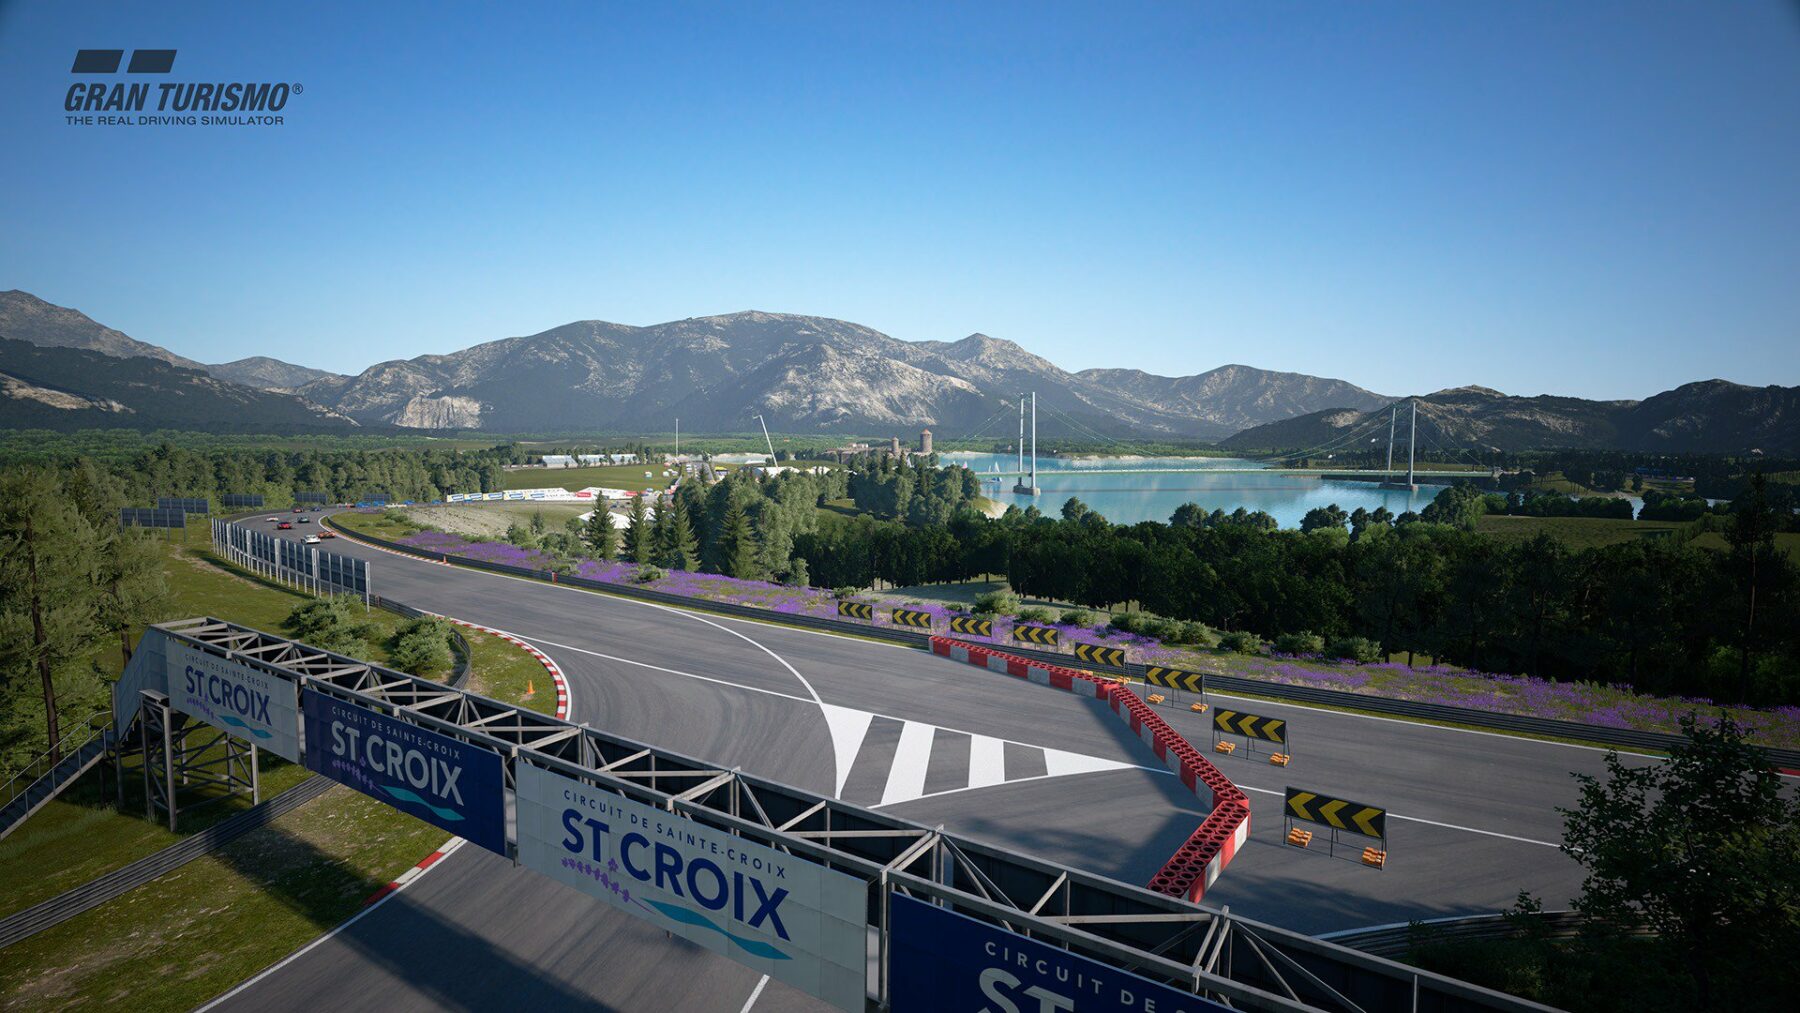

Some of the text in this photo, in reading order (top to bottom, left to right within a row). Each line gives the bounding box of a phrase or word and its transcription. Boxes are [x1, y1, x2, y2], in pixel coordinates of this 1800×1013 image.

[185, 665, 272, 726] ST CROIX
[332, 706, 460, 760] CIRCUIT DE SAINTE-CROIX
[331, 720, 464, 806] ST CROIX
[564, 790, 786, 879] CIRCUIT DE SAINTE-CROIX
[562, 808, 791, 942] ST CROIX
[985, 941, 1156, 1013] CIRCUIT DE
